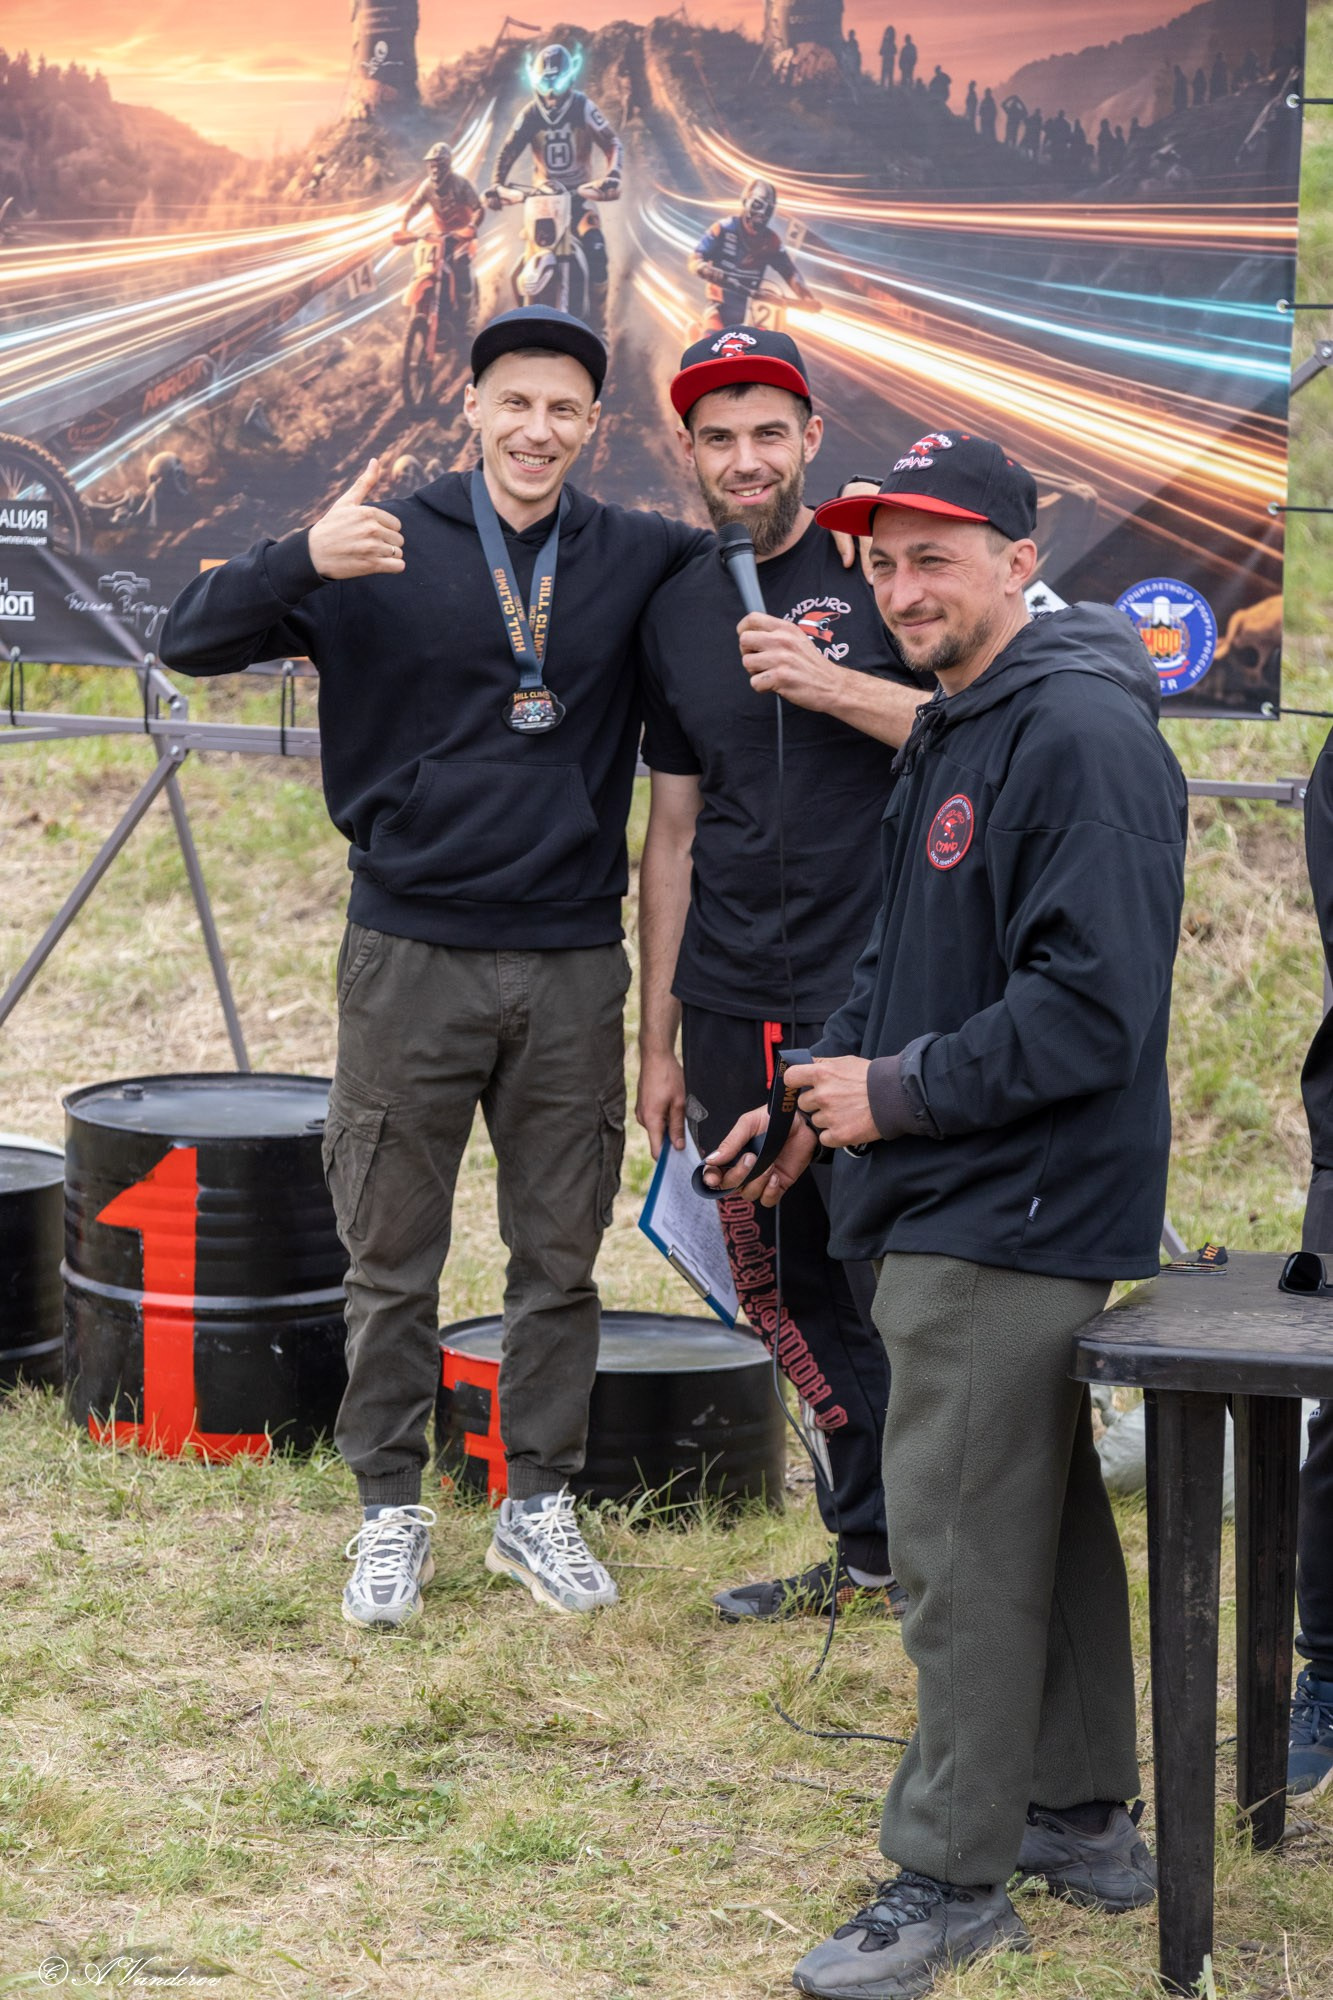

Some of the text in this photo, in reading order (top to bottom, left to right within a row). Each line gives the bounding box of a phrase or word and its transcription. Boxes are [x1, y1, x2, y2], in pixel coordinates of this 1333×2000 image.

[493, 568, 527, 653] HILL CLIMB
[538, 576, 552, 611] HILL
[784, 596, 852, 622] ENDURO
[1118, 582, 1194, 612] ОТОЦИКЛЕТНОГО
[88, 1145, 271, 1464] 1
